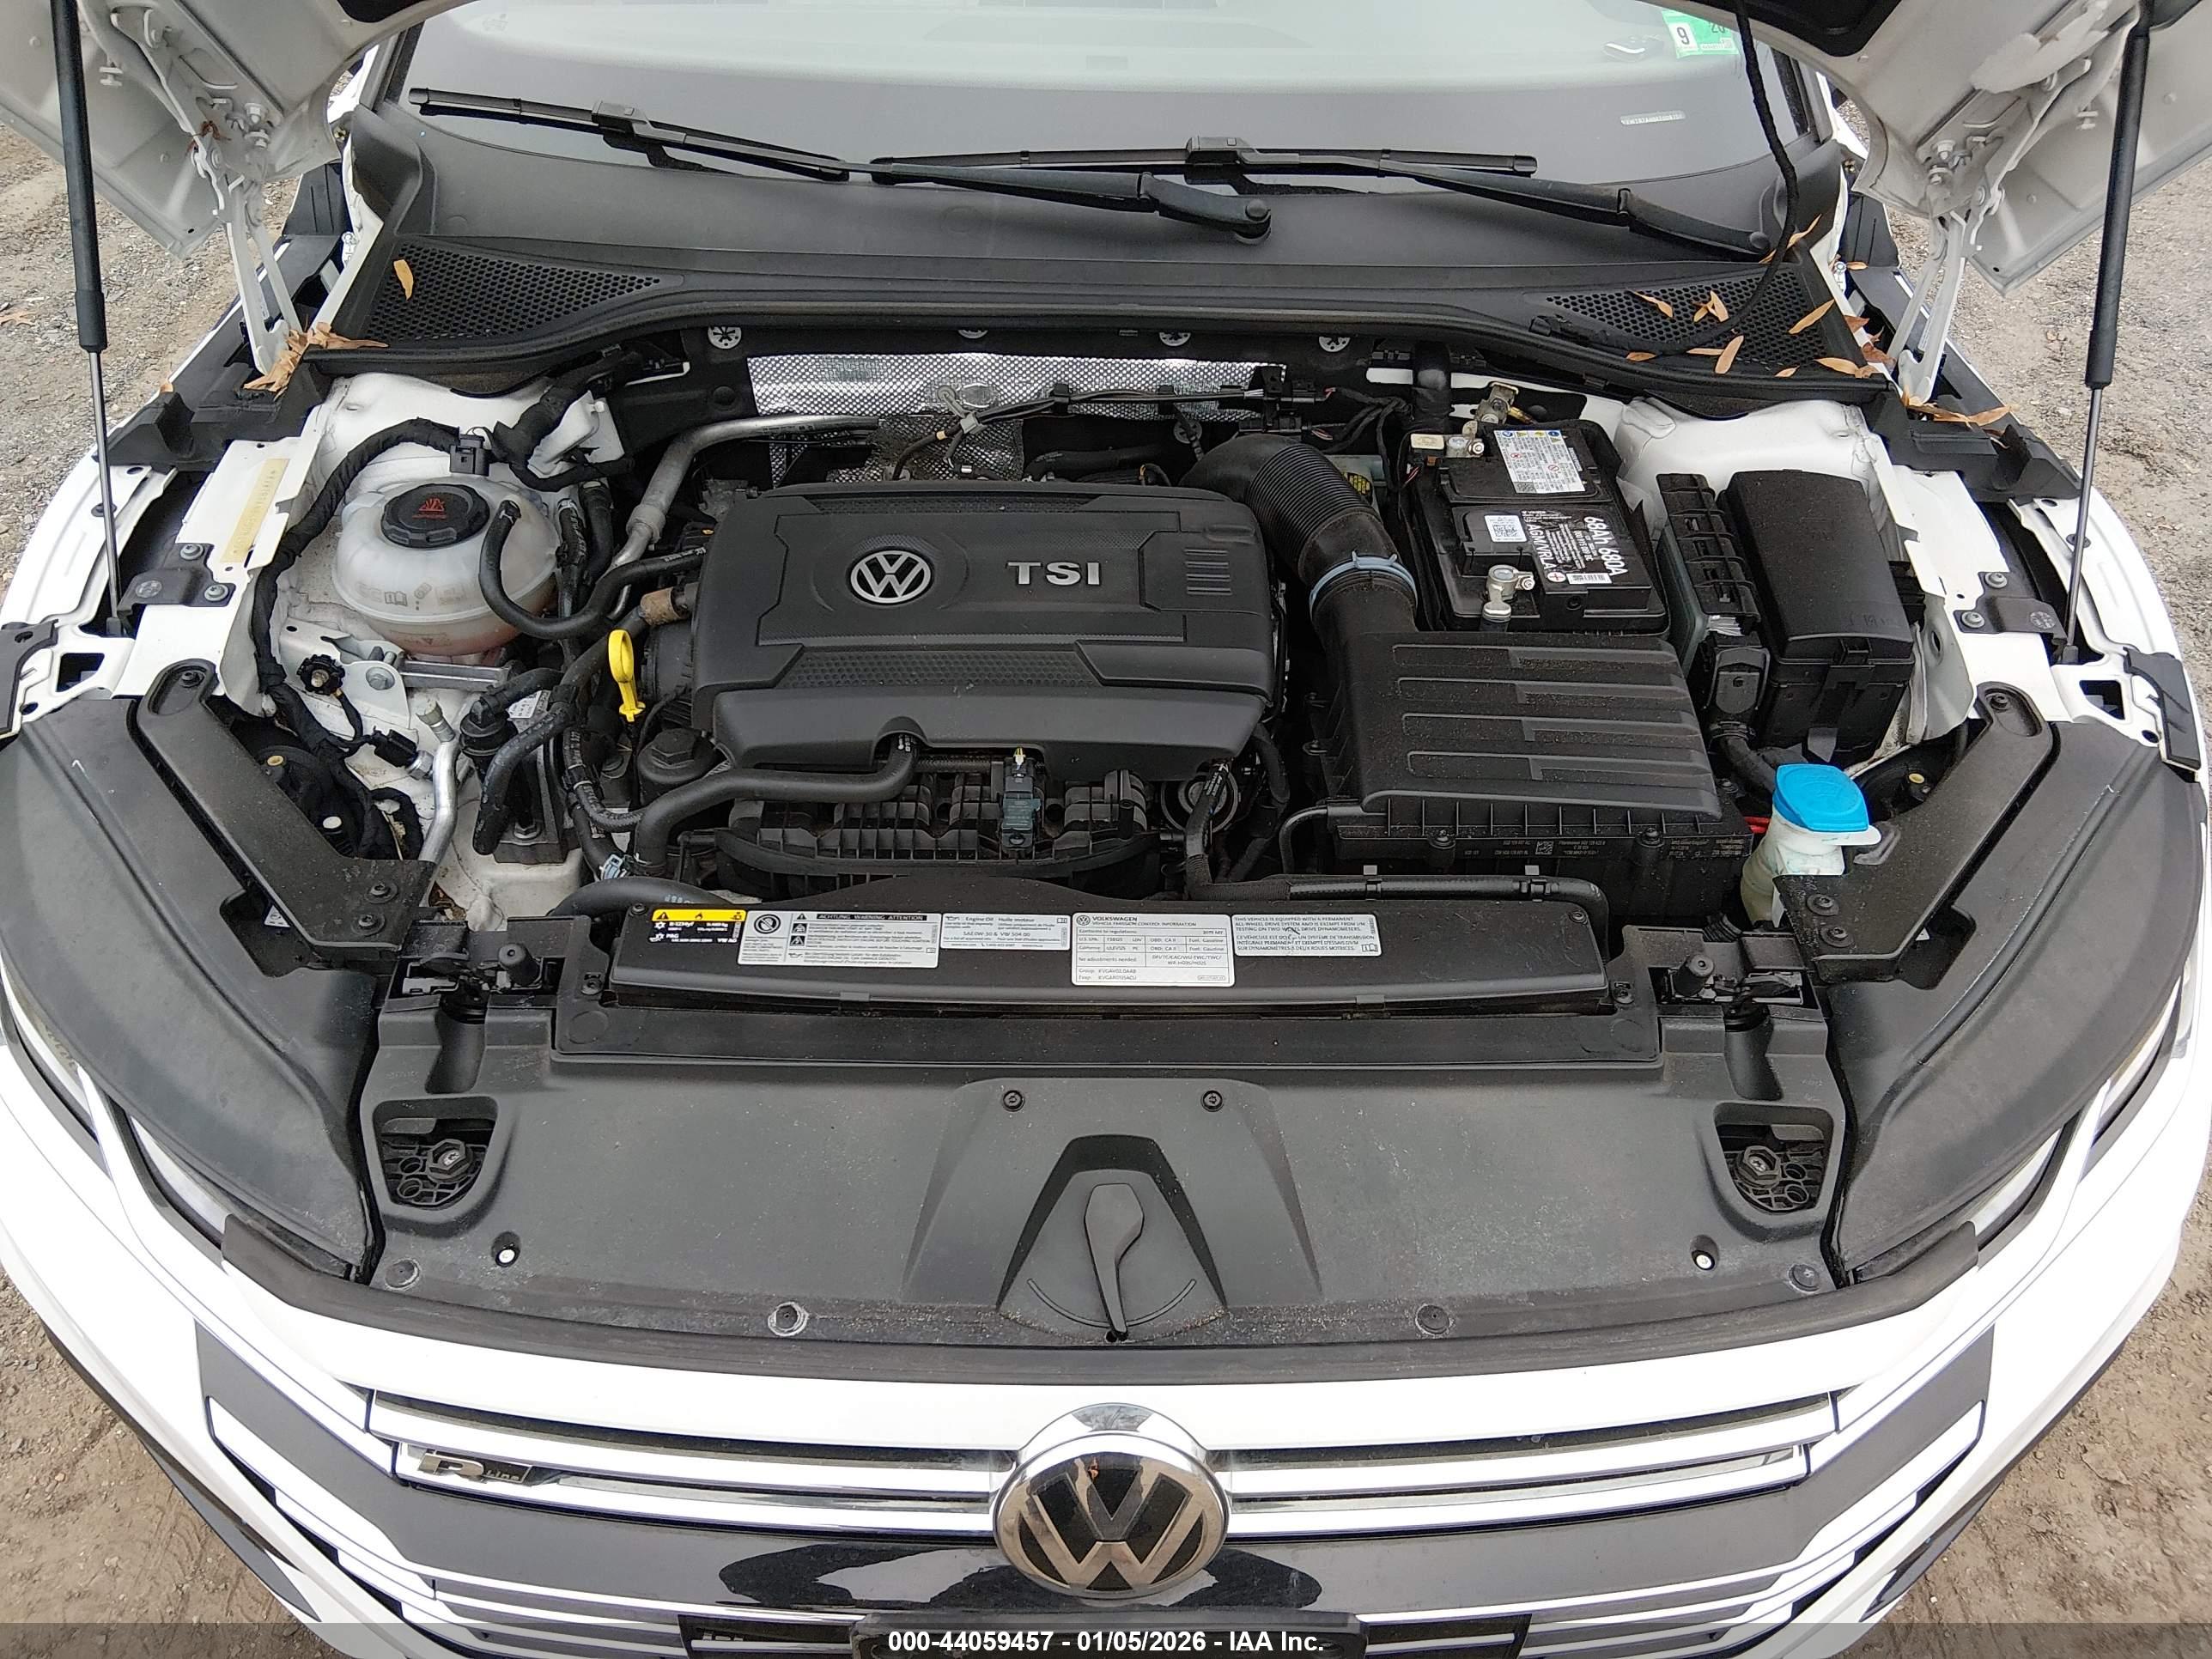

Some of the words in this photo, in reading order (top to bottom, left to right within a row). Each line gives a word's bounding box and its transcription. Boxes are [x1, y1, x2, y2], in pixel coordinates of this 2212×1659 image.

[1676, 27, 1690, 45] 9
[1584, 516, 1614, 544] 68Ah
[1007, 562, 1100, 586] TSI
[1598, 547, 1629, 576] 680A
